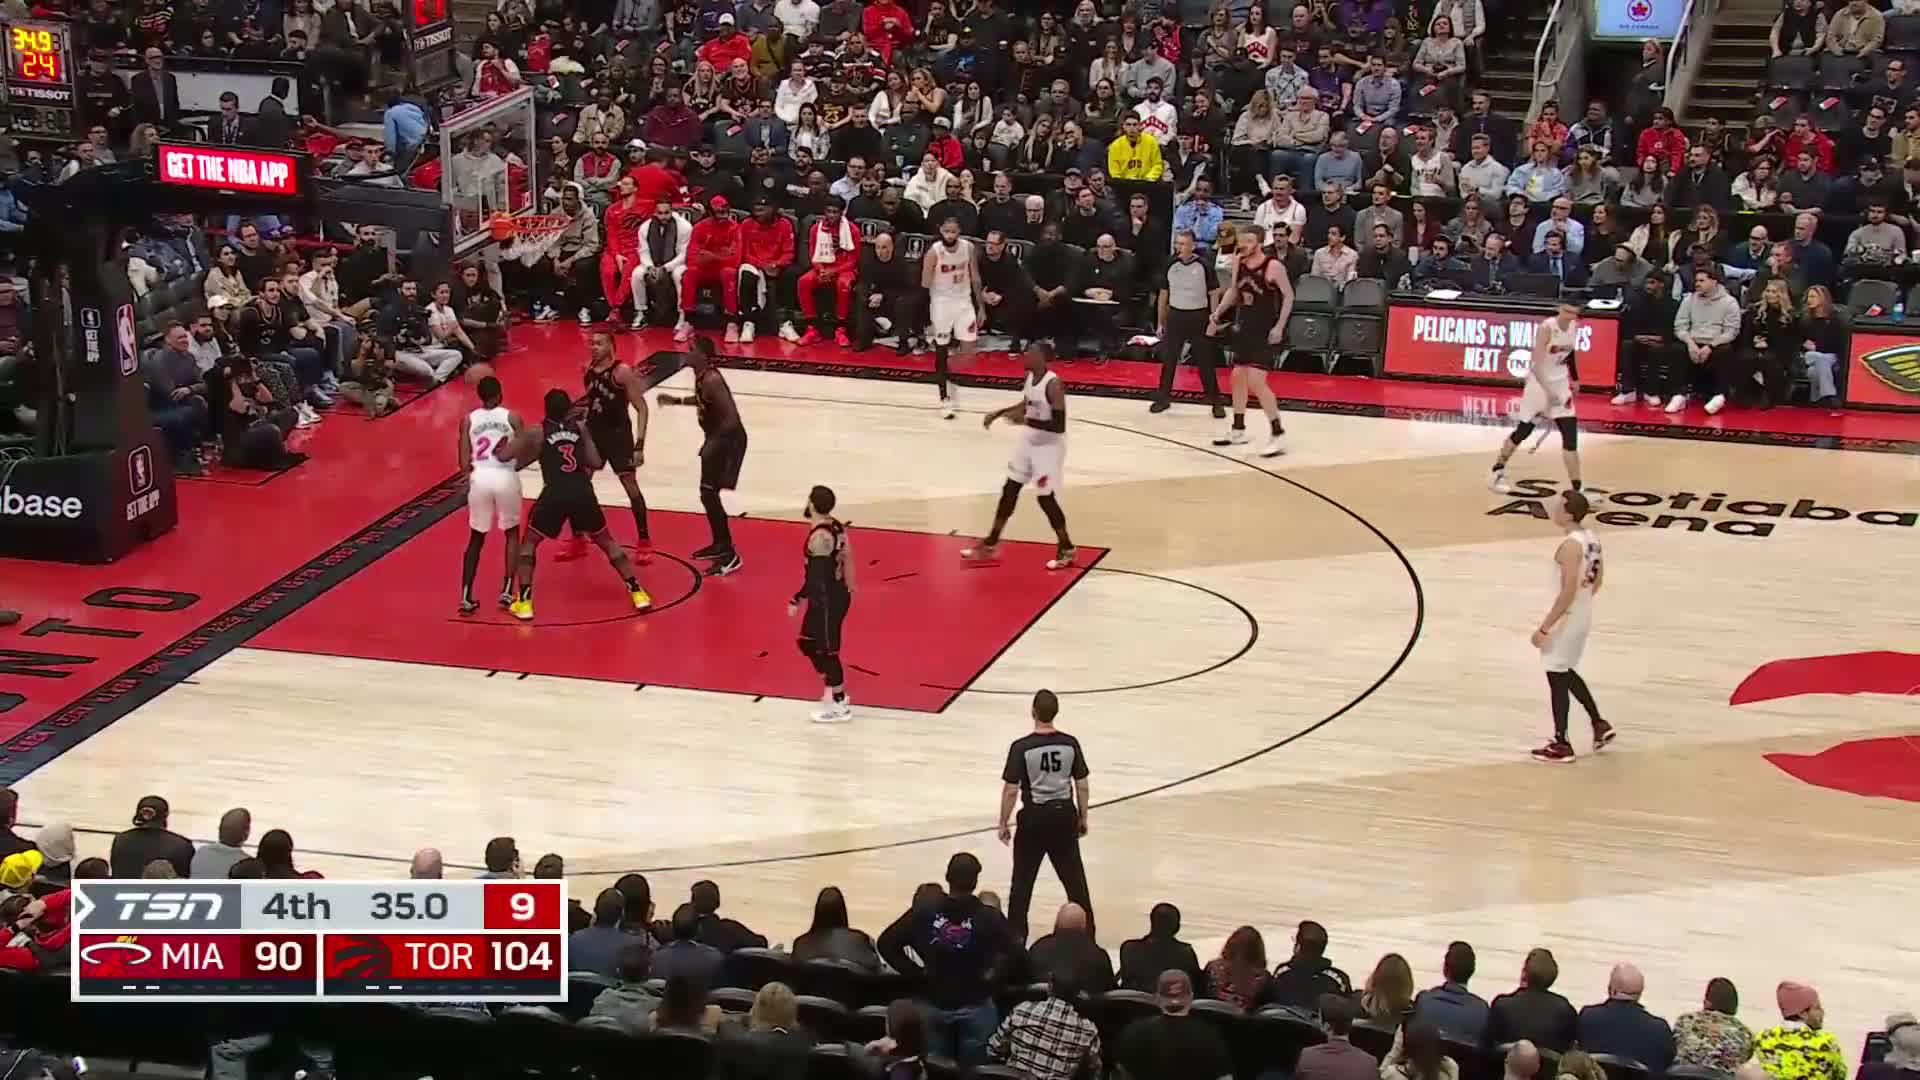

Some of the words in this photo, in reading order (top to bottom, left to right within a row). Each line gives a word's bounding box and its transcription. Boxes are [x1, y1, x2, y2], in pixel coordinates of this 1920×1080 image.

[23, 51, 55, 77] 24
[166, 151, 195, 179] GET
[196, 155, 226, 182] THE
[227, 157, 259, 185] NBA
[260, 160, 288, 188] APP
[1413, 314, 1486, 345] PELICANS
[1464, 347, 1501, 372] NEXT
[559, 444, 577, 472] 3
[0, 485, 83, 519] base
[1505, 479, 1920, 527] Sotiaba
[1487, 499, 1776, 537] Aena
[1040, 751, 1062, 773] 45
